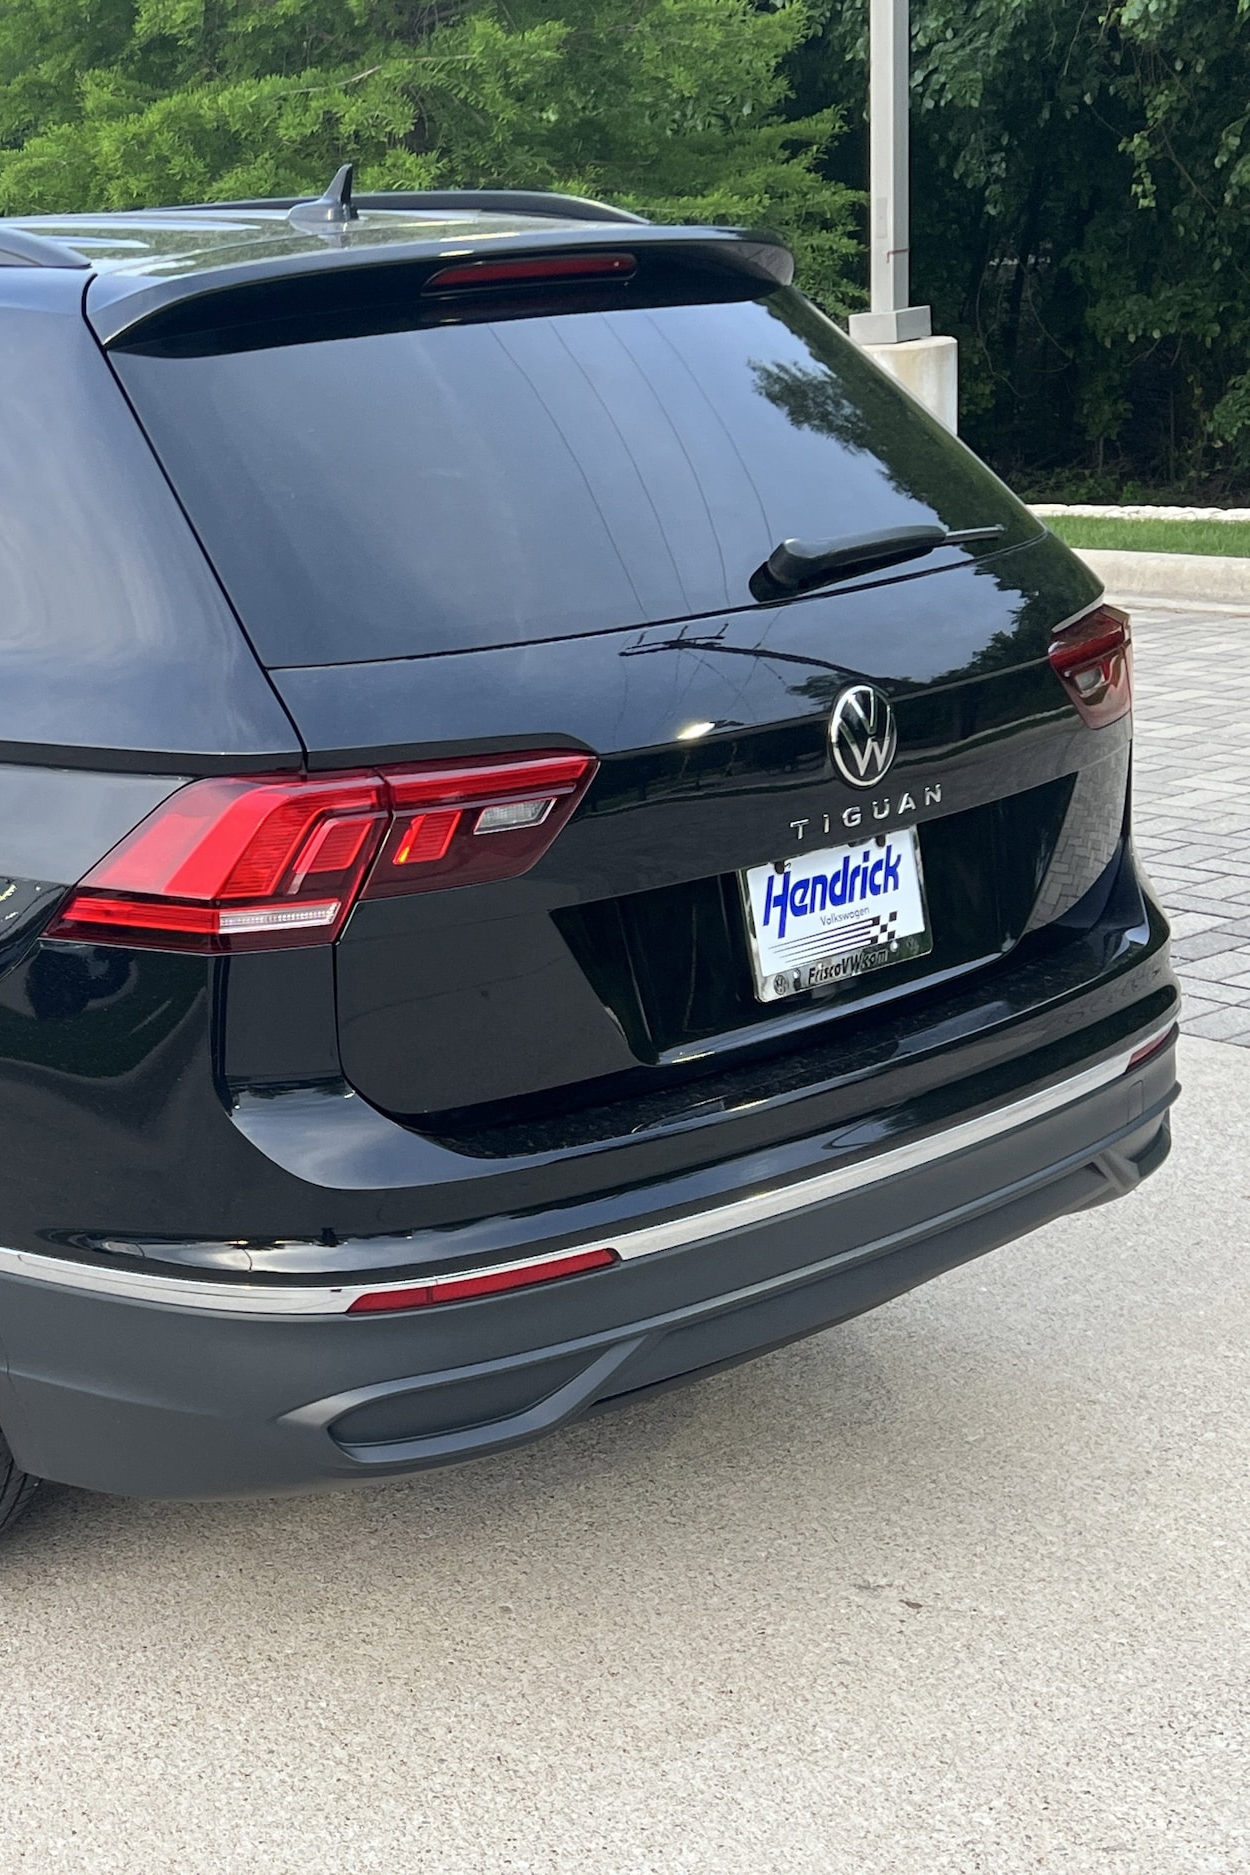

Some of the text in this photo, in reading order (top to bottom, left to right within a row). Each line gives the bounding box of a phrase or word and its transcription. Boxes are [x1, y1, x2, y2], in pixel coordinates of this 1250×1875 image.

[831, 684, 896, 787] VW
[790, 783, 942, 840] TIGUAN
[762, 844, 902, 939] Hendrick
[819, 906, 870, 928] Volkswagen
